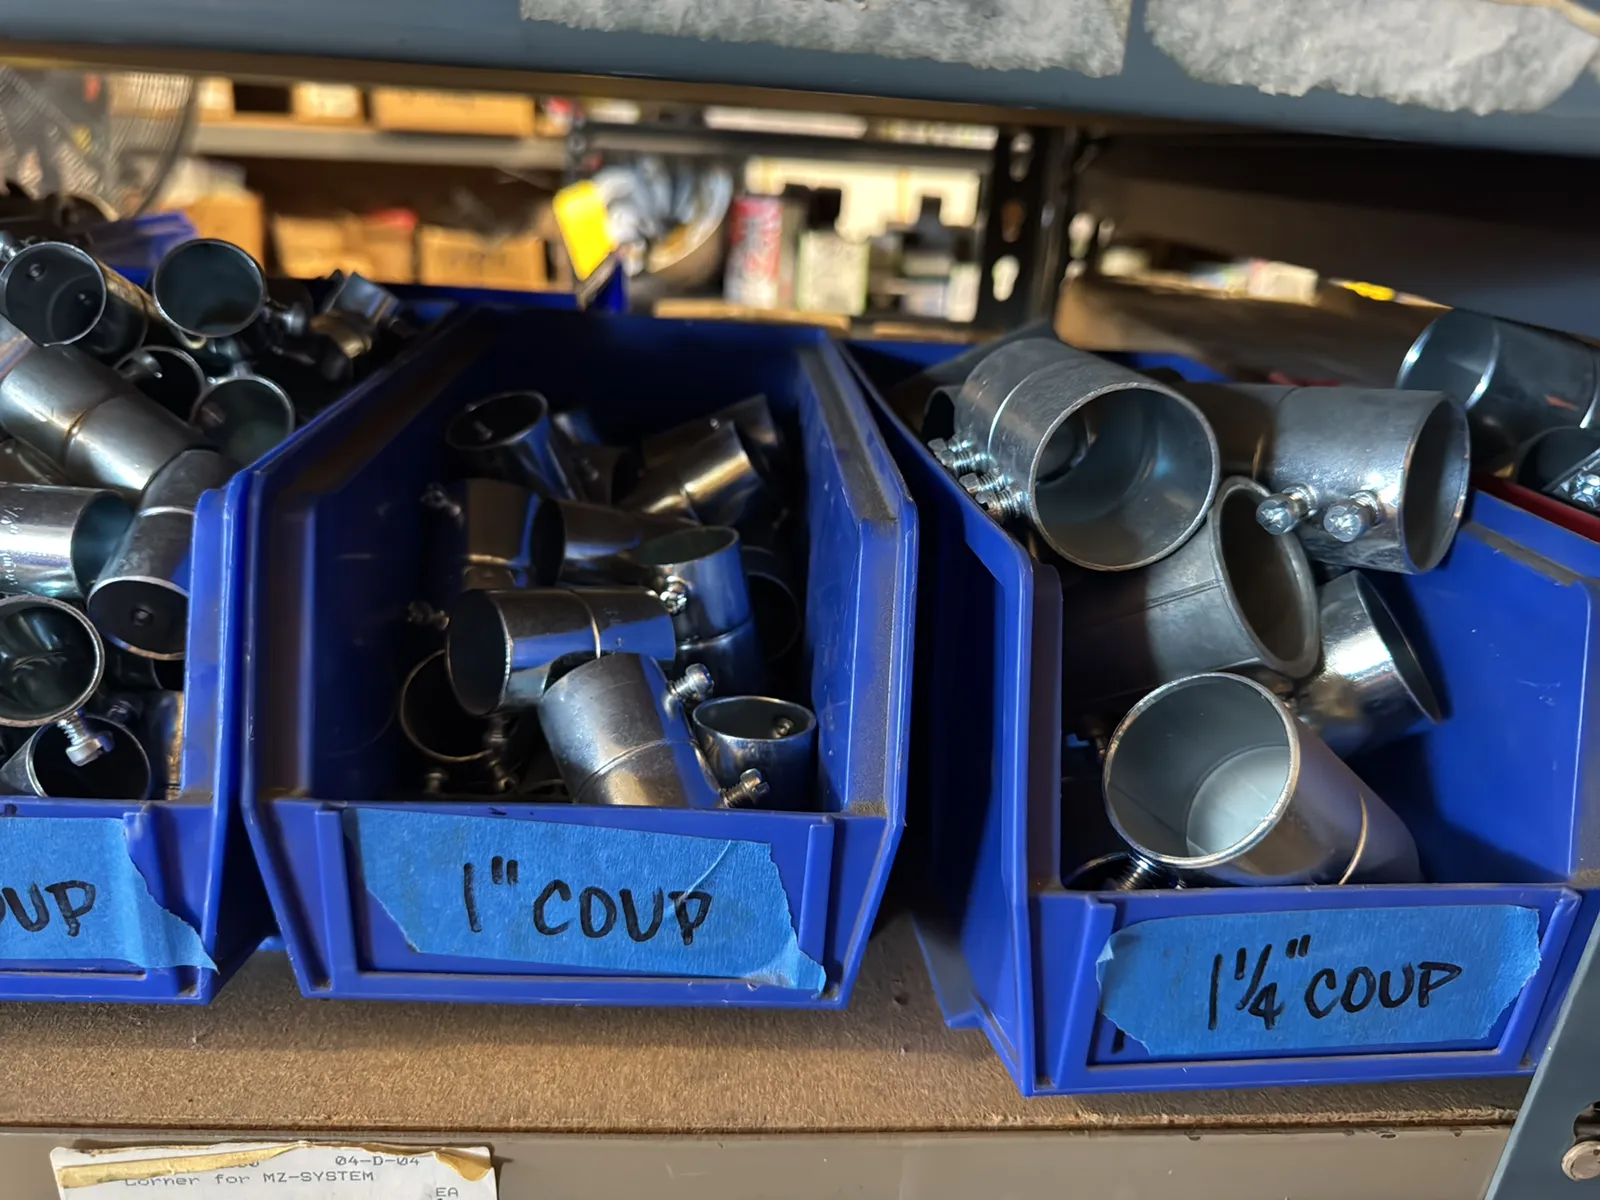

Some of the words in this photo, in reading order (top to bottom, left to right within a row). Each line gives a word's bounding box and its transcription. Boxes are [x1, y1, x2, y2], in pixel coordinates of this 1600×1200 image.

[463, 855, 519, 933] 1"
[533, 879, 713, 946] COUP
[1304, 961, 1462, 1020] COUP
[215, 1173, 251, 1184] for
[262, 1171, 374, 1183] MZ-SYSTEM
[435, 1187, 459, 1197] EA
